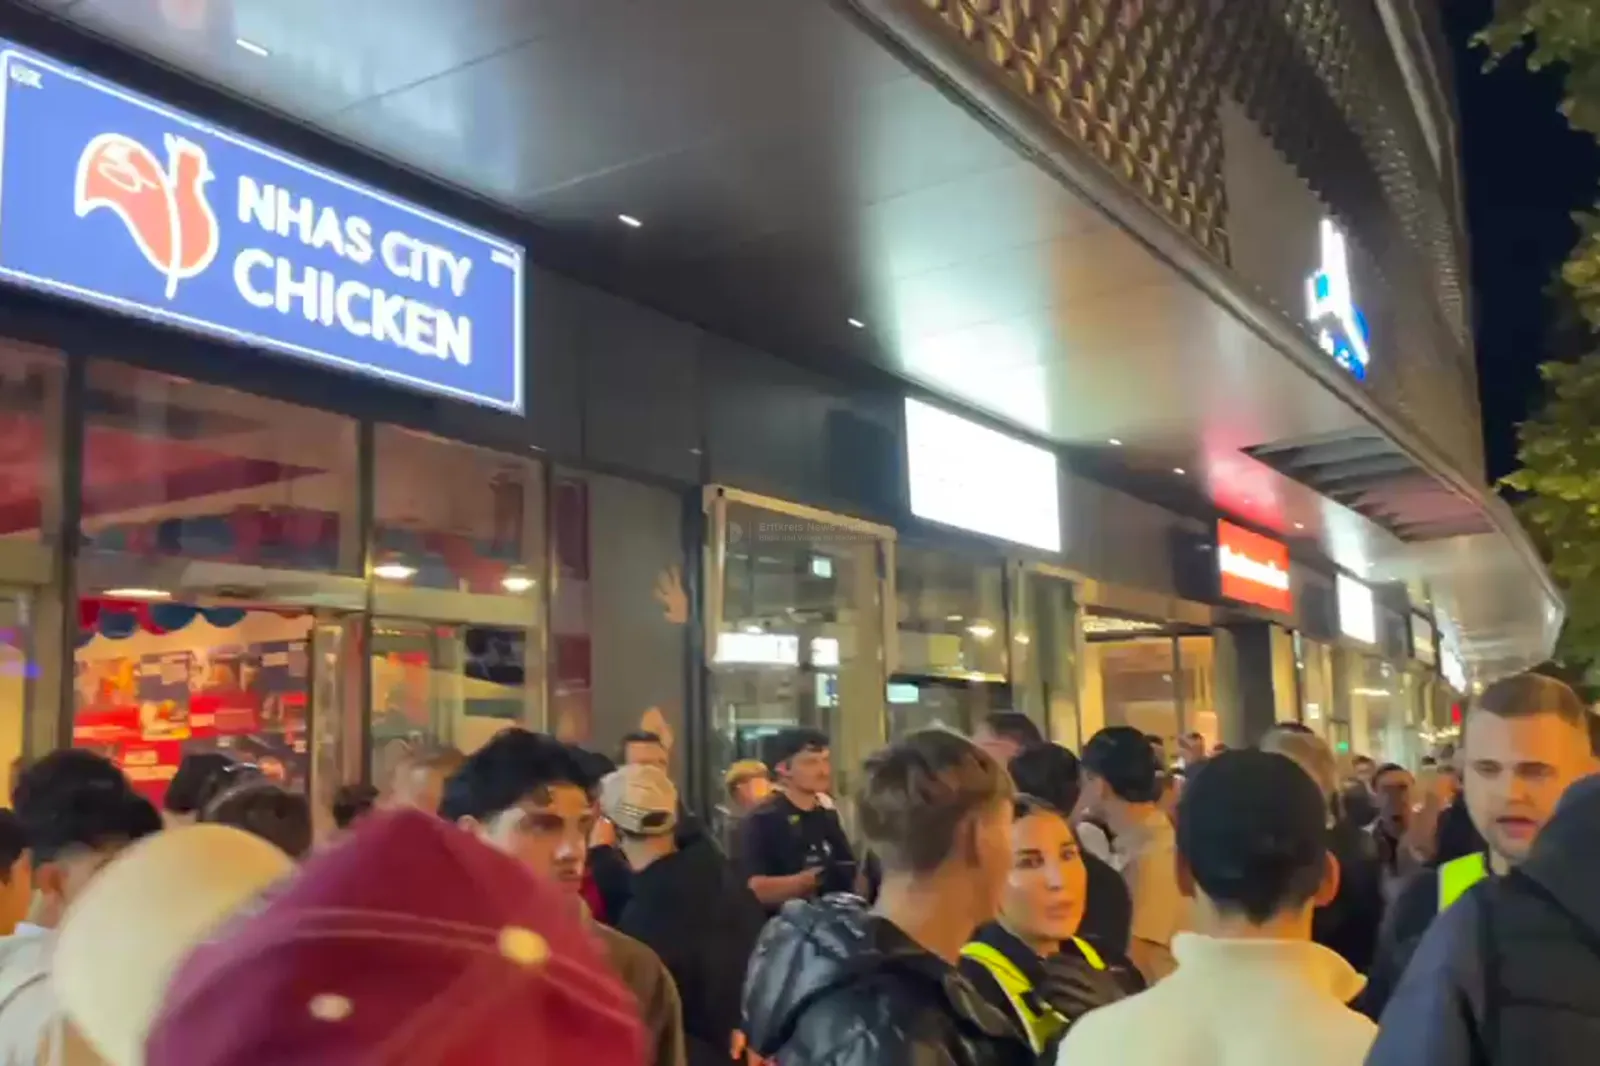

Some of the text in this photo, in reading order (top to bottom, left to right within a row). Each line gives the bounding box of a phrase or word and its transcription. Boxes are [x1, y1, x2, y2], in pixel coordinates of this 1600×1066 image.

[237, 174, 473, 297] NHAS CITY
[233, 248, 472, 367] CHICKEN
